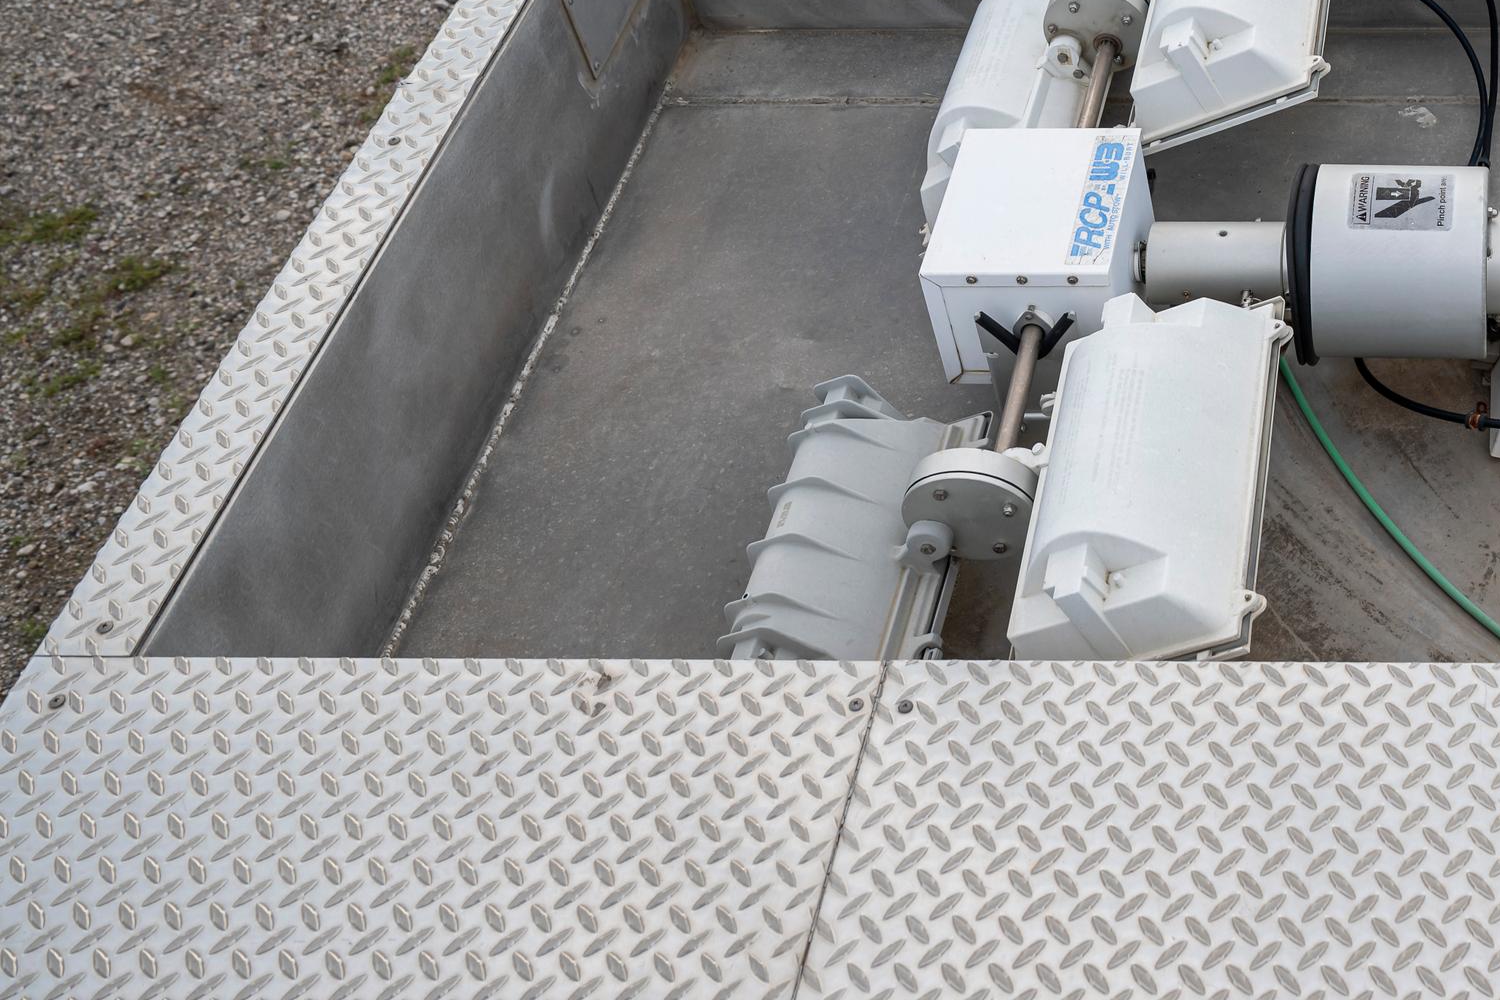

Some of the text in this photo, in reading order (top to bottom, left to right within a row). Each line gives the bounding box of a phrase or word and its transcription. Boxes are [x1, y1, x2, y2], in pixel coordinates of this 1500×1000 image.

[1358, 176, 1370, 213] WARNING
[1439, 185, 1448, 204] point
[1074, 191, 1110, 249] RCP
[1106, 213, 1116, 232] AUTO
[1436, 203, 1446, 227] Pinch
[1103, 234, 1113, 249] WITH
